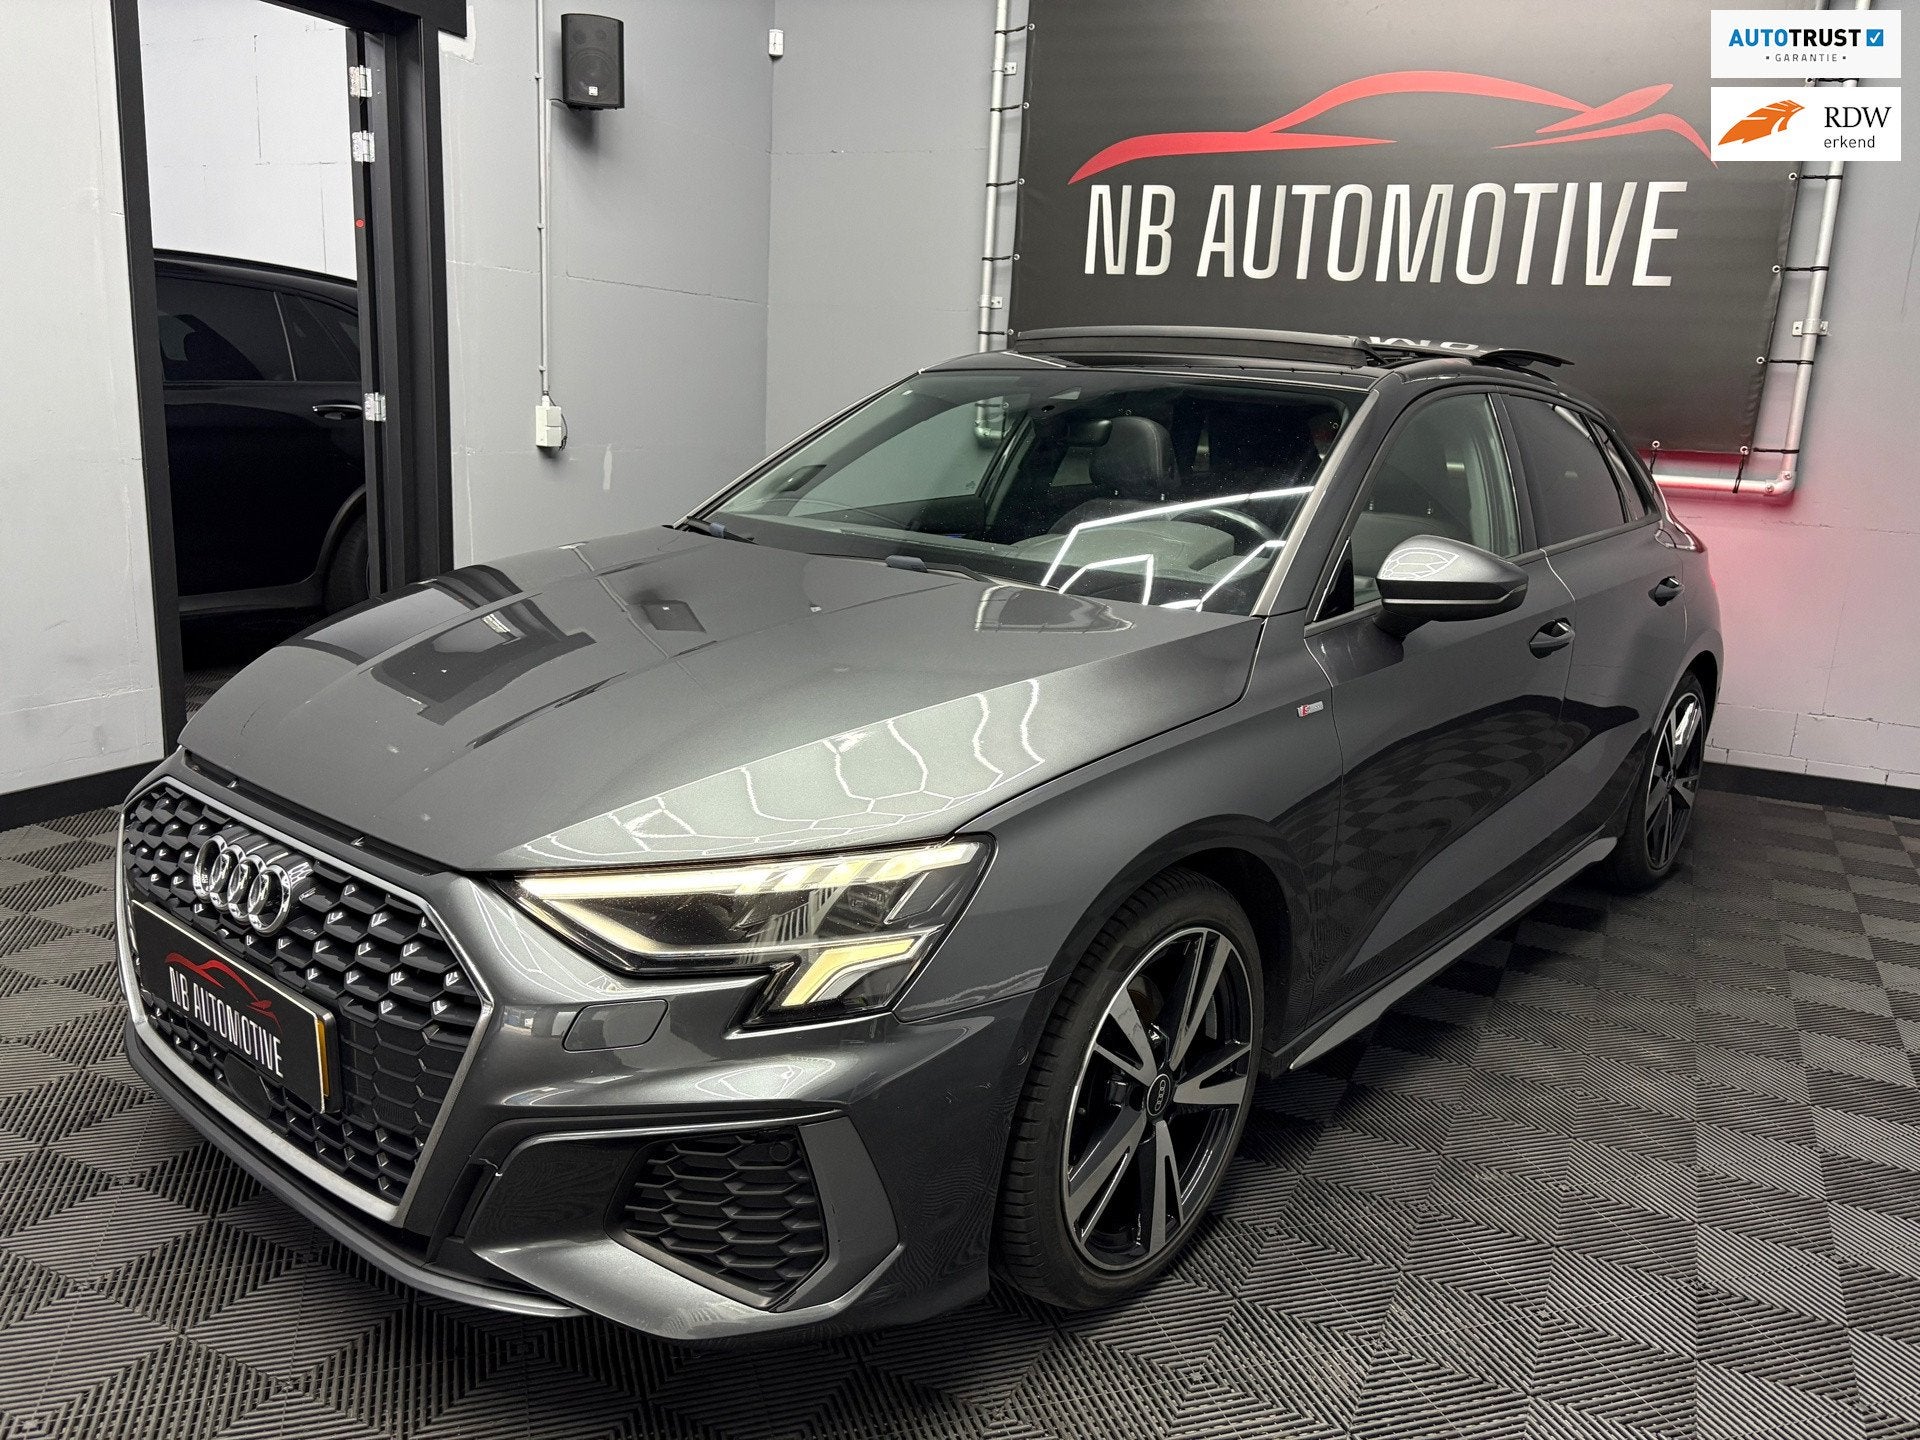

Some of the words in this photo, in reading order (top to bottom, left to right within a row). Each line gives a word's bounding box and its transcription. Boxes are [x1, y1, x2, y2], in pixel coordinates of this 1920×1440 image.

[1084, 184, 1176, 276] NB
[1196, 181, 1688, 287] AUTOMOTIVE
[169, 966, 190, 1012] NB
[193, 982, 284, 1079] AUTOMOTIVE
